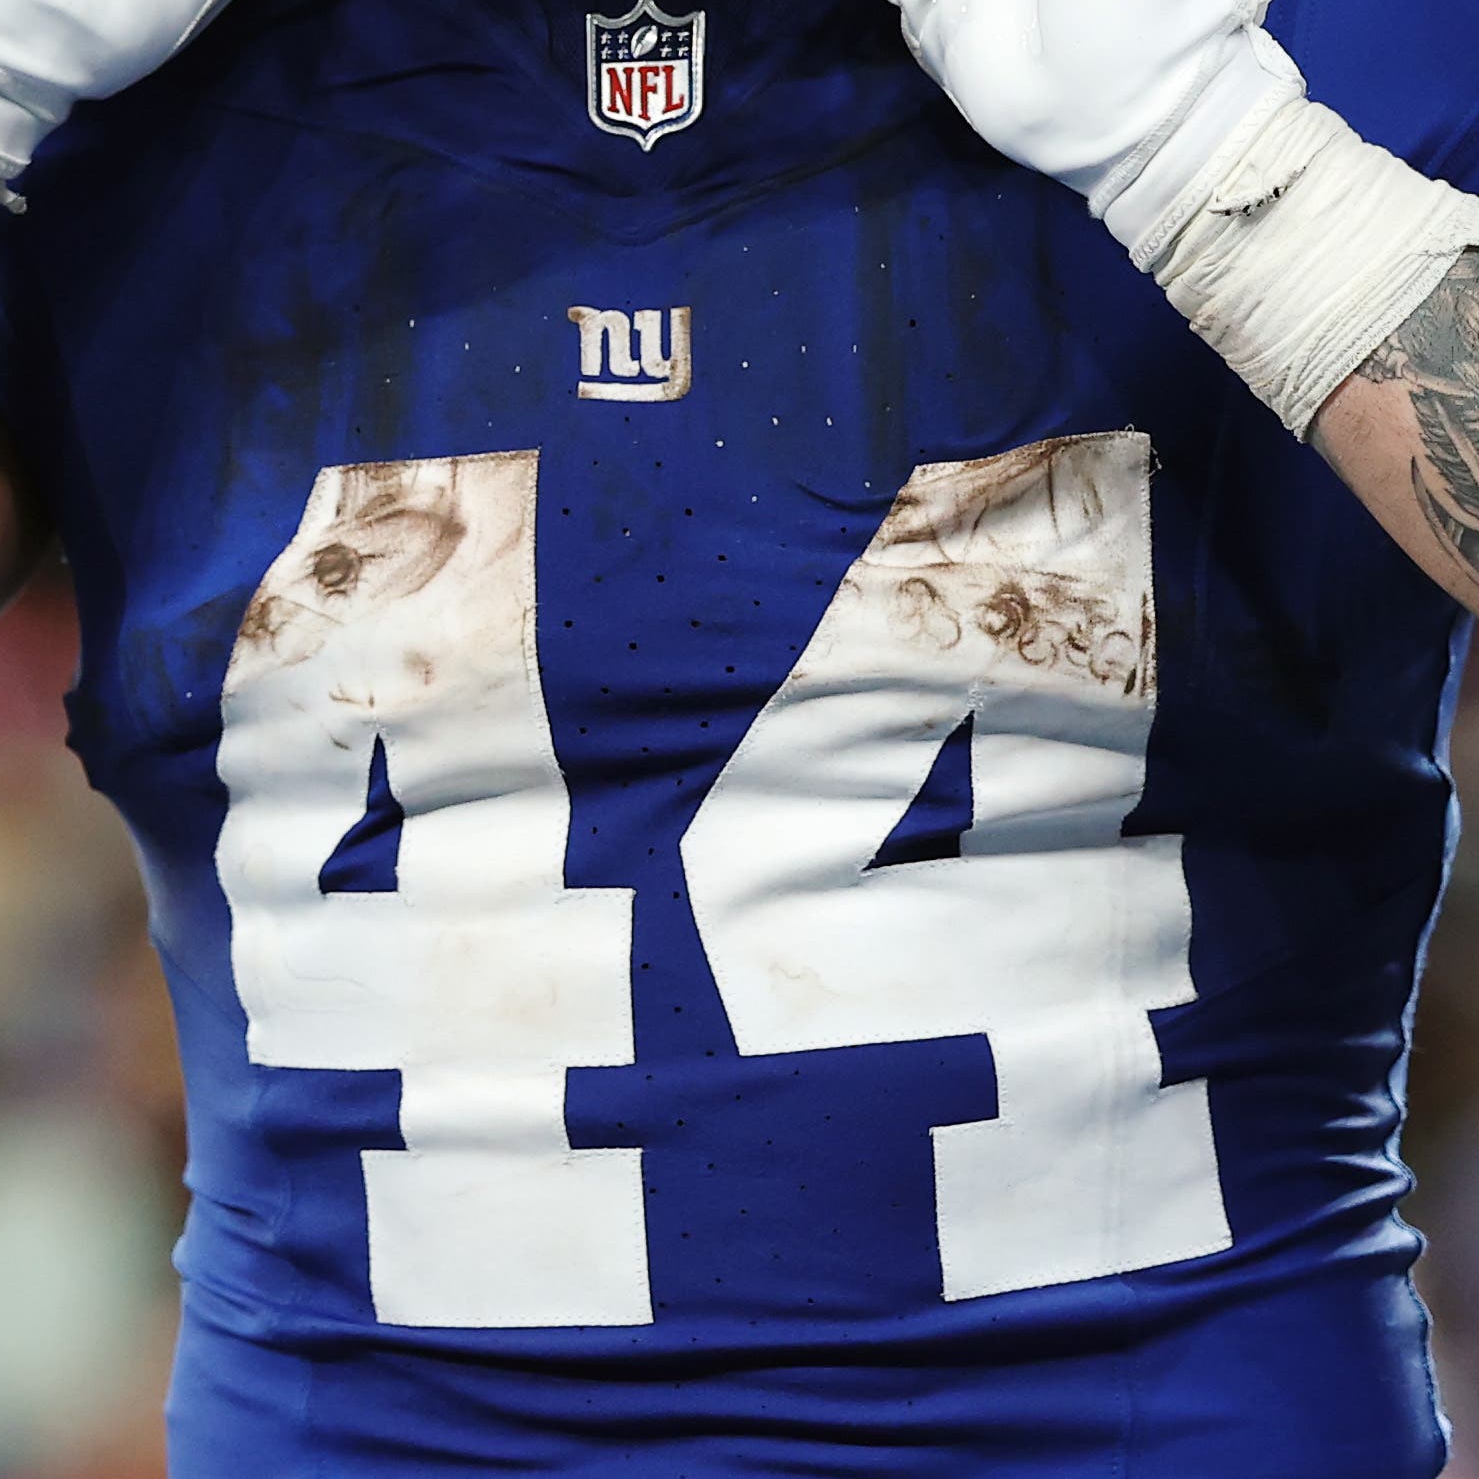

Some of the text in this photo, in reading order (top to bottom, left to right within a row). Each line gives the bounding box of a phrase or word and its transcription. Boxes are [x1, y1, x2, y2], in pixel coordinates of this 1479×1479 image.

[606, 64, 684, 121] NFL
[567, 306, 692, 402] ny
[214, 432, 1233, 1327] 44
